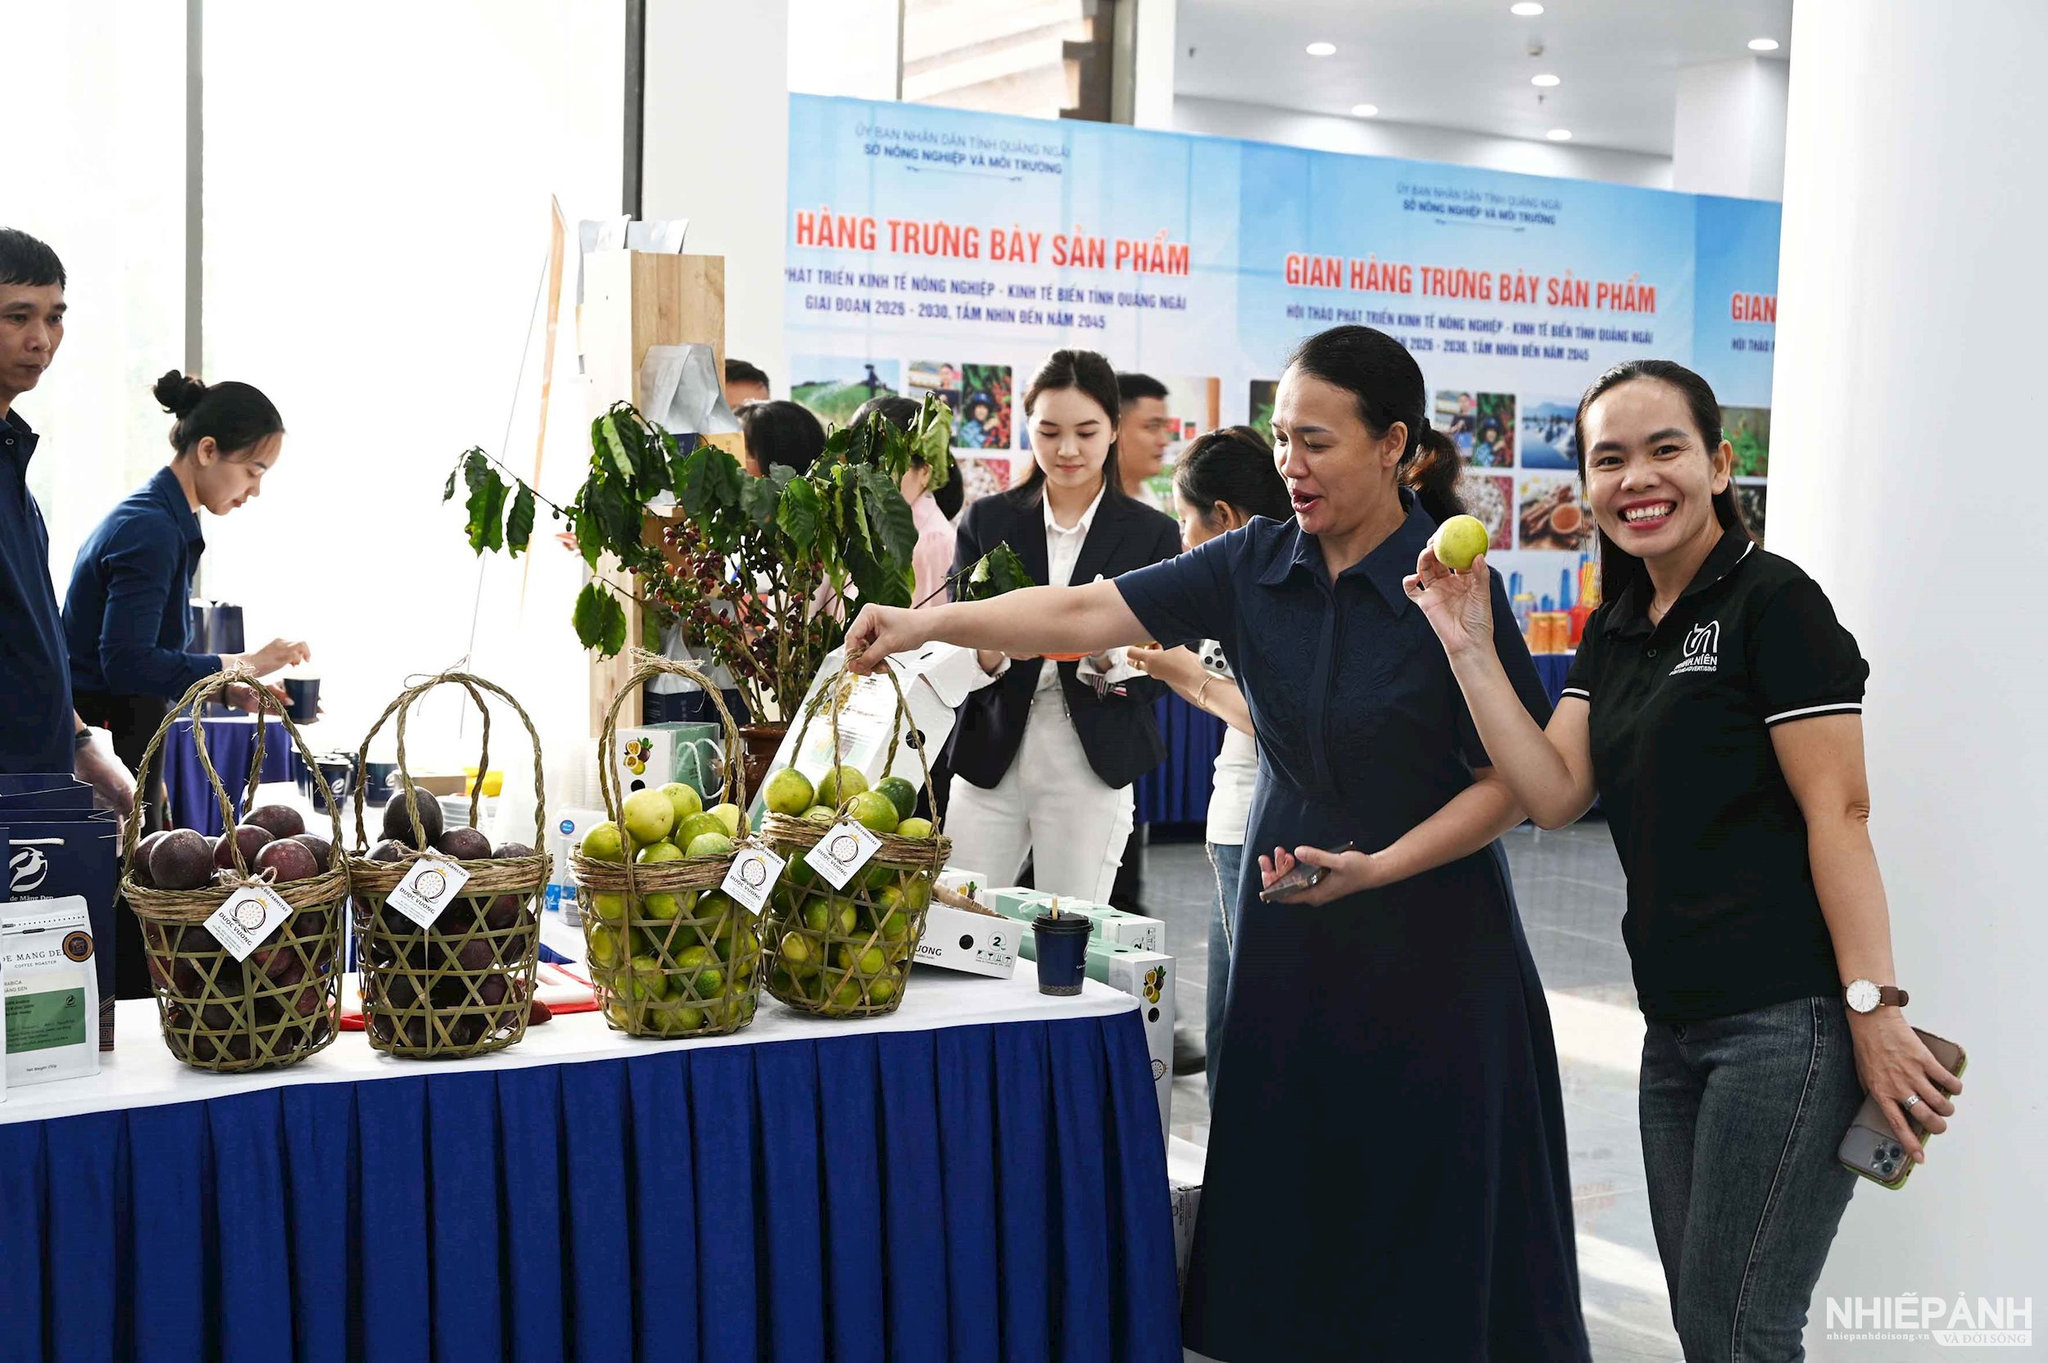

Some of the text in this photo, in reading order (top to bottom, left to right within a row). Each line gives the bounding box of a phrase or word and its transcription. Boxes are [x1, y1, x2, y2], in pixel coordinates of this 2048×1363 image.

[875, 126, 899, 139] BAN
[903, 127, 937, 143] NHÂN
[942, 131, 966, 147] DÂN
[884, 144, 919, 160] NÔNG
[922, 149, 966, 167] NGHIỆP
[970, 152, 985, 166] VÀ
[989, 156, 1012, 169] MÔI
[1015, 157, 1062, 174] TRƯỜNG
[796, 207, 1190, 276] HÀNG TRƯNG BÀY SẢN PHẨM
[818, 267, 854, 286] TRIỂN
[859, 271, 889, 289] KINH
[895, 270, 907, 290] TẾ
[912, 275, 946, 294] NÔNG
[950, 279, 995, 298] NGHIỆP
[1008, 284, 1036, 299] KINH
[1041, 282, 1052, 300] TẾ
[1058, 282, 1084, 303] BIỂN
[1285, 253, 1657, 314] GIAN HÀNG TRƯNG BÀY SẢN PHẨM
[805, 295, 831, 311] GIAI
[836, 297, 871, 316] ĐOẠN
[957, 300, 981, 321] TẦM
[986, 307, 1015, 324] NHÌN
[1019, 308, 1043, 326] ĐẾN
[1047, 308, 1074, 327] NĂM
[1078, 314, 1106, 329] 2045
[1286, 304, 1304, 320] HỘI
[1308, 305, 1334, 322] THẢO
[1337, 307, 1362, 322] PHÁT
[1366, 306, 1394, 325] TRIỂN
[1397, 311, 1421, 327] KINH
[1424, 310, 1435, 328] TẾ
[1438, 313, 1465, 331] NÔNG
[1468, 316, 1503, 334] NGHIỆP
[1513, 321, 1535, 336] KINH
[1538, 320, 1548, 337] TẾ
[1552, 321, 1573, 339] BIỂN
[1732, 292, 1777, 323] GIAN
[16, 951, 46, 961] MANG
[48, 949, 64, 957] DE
[992, 936, 1002, 947] 2
